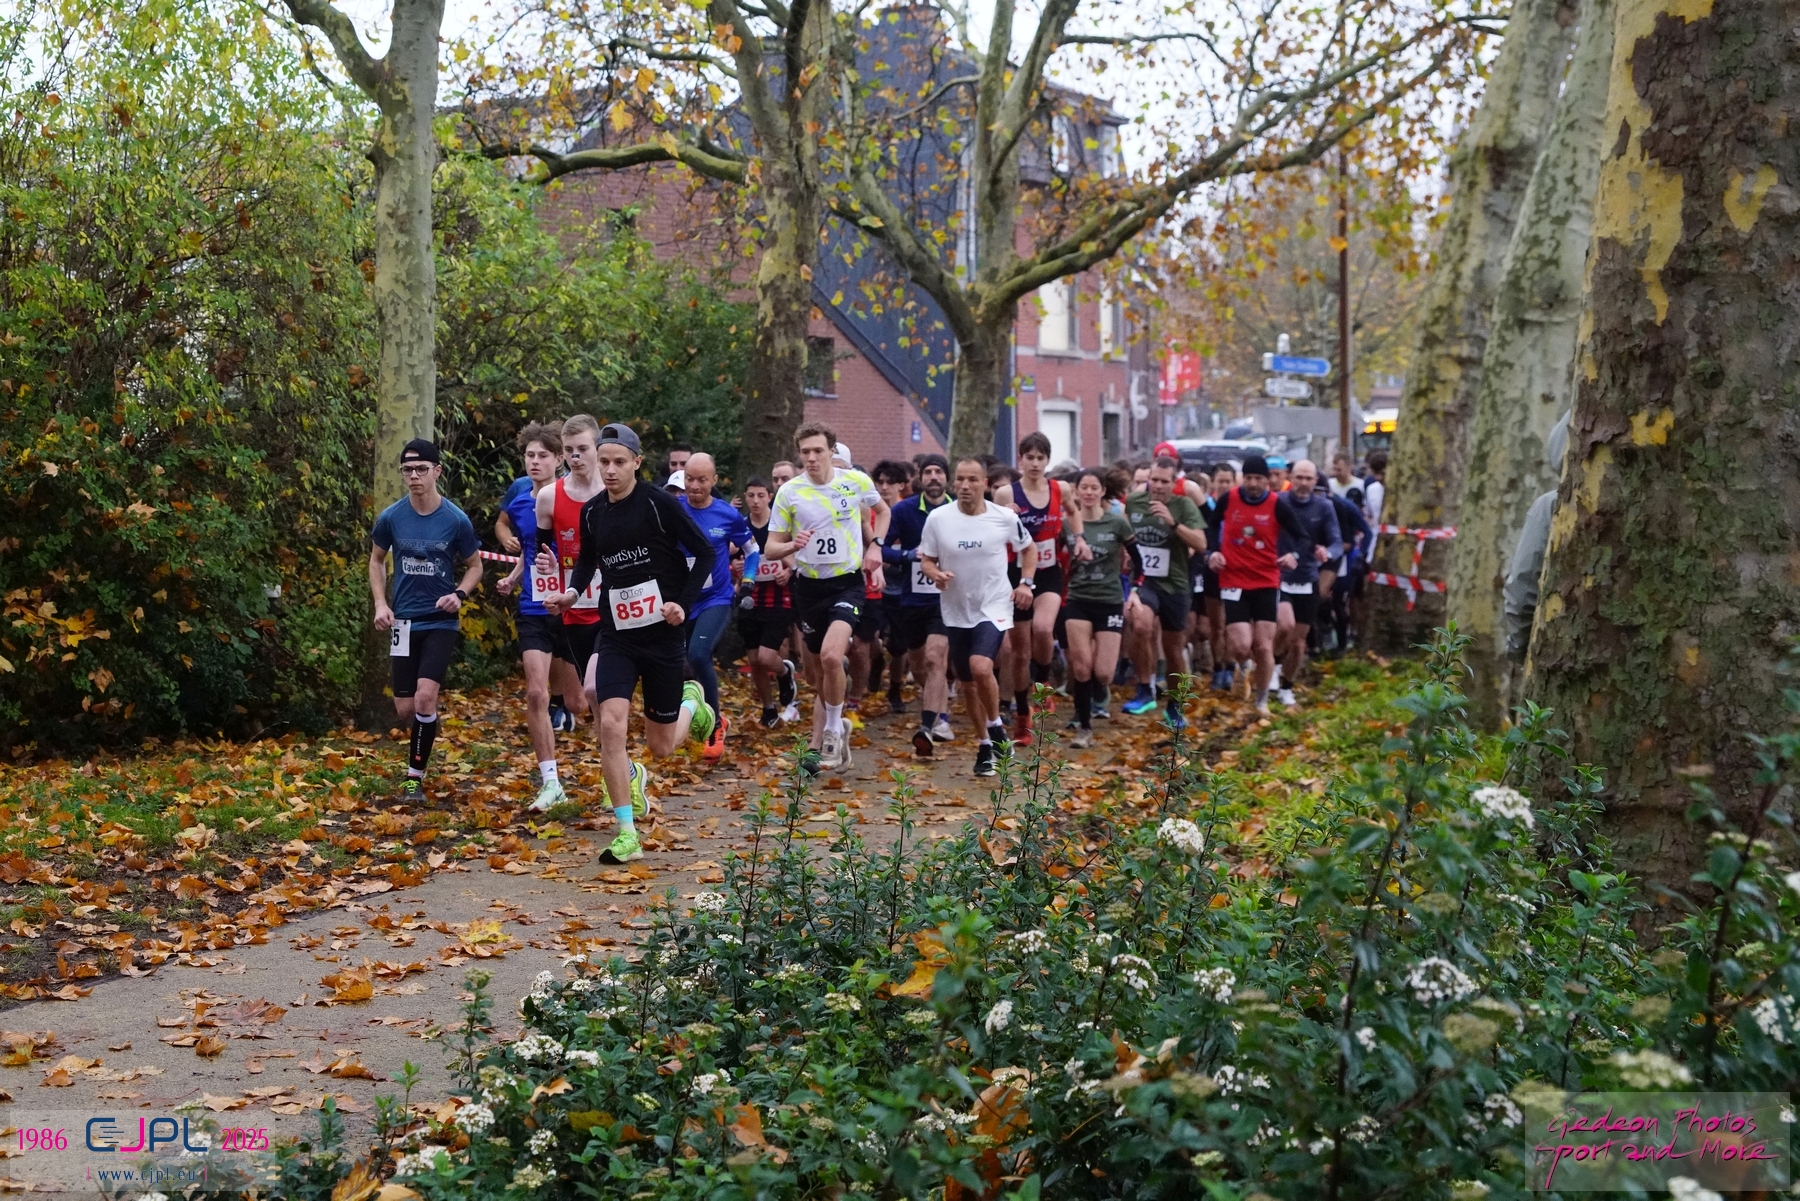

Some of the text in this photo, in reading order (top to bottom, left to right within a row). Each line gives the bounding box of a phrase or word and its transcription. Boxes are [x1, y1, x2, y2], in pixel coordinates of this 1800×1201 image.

[816, 537, 837, 555] 28
[958, 540, 983, 550] RUN
[756, 562, 779, 575] 62
[1144, 554, 1160, 569] 22
[535, 576, 559, 593] 98
[615, 595, 657, 621] 857
[391, 628, 400, 647] 5
